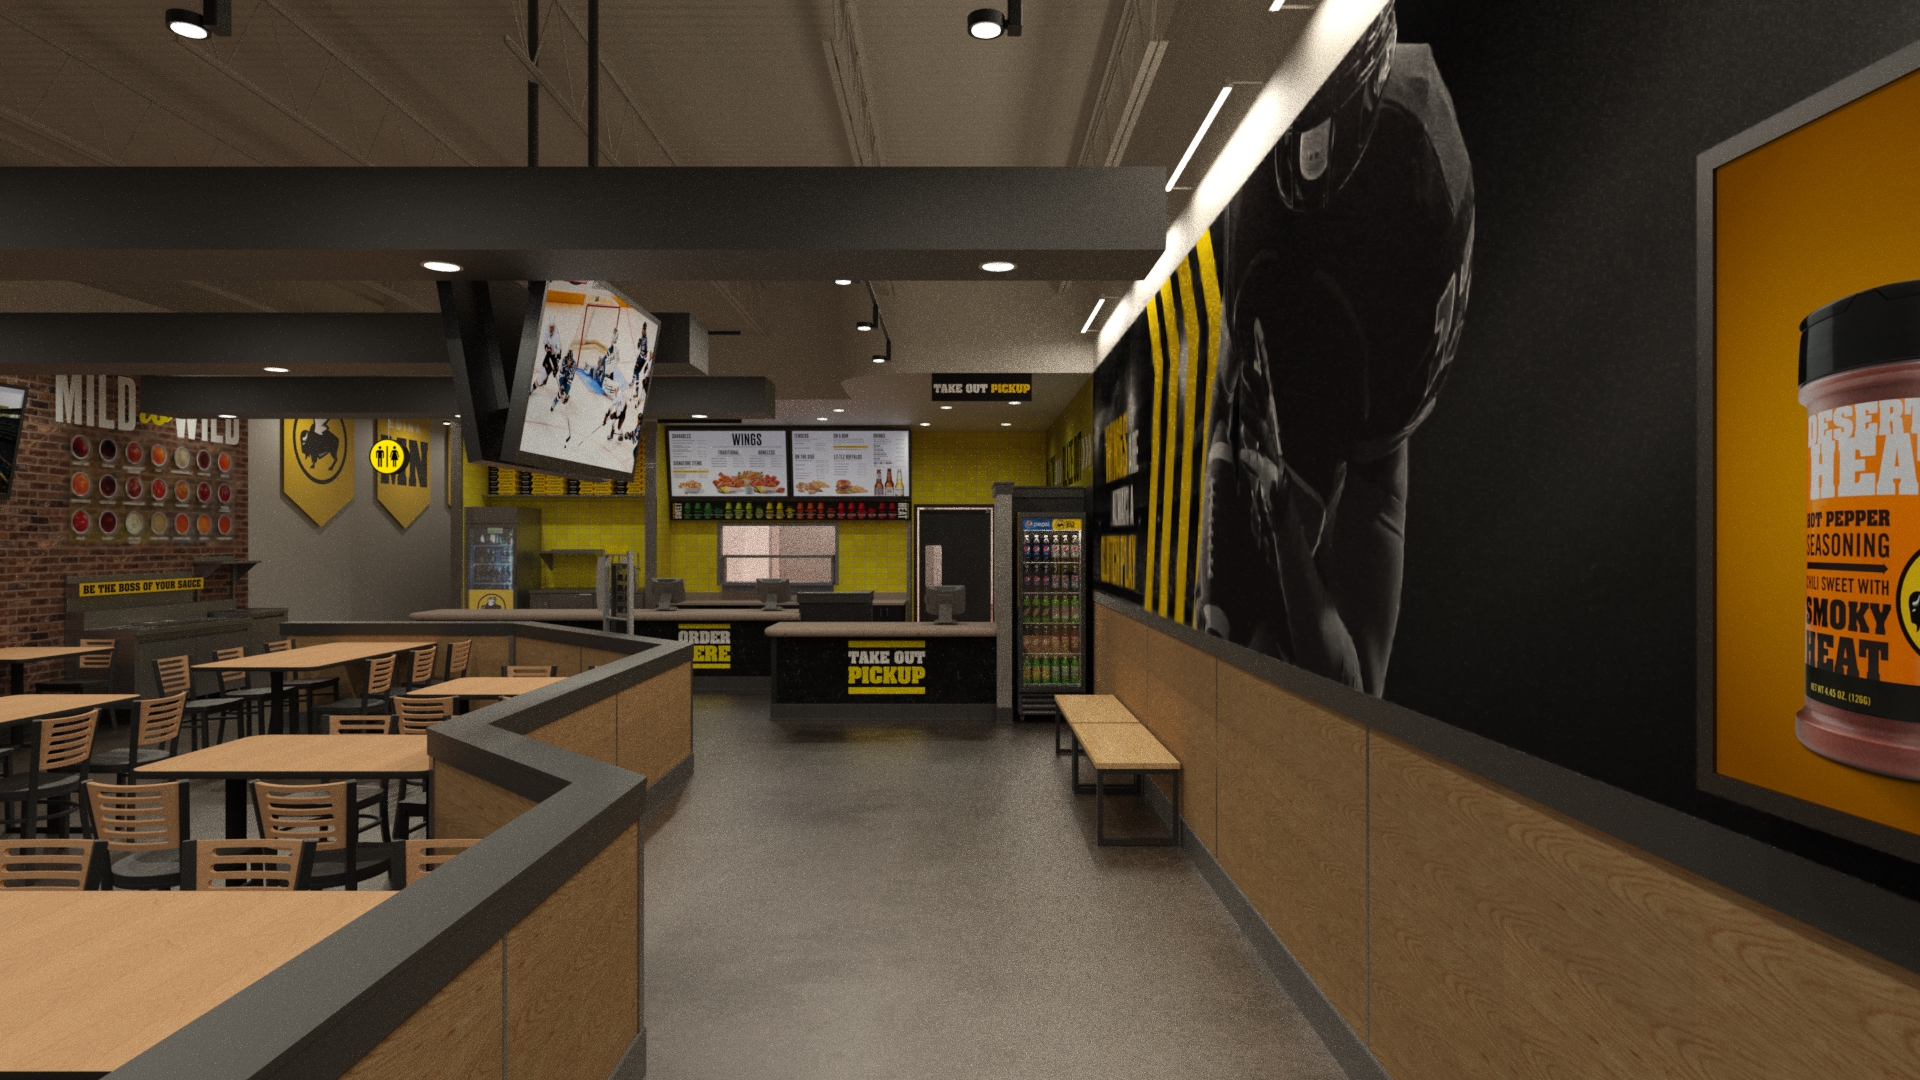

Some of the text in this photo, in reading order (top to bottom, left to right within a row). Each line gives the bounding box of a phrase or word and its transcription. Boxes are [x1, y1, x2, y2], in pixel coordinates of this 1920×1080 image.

[933, 383, 1031, 394] TAKE OUT PICKUP
[55, 375, 136, 431] MILD
[1808, 398, 1920, 448] DESERT
[732, 433, 762, 446] WINGS
[1810, 433, 1920, 500] HEA
[898, 502, 908, 520] HEAT
[1807, 509, 1890, 528] HOT PEPPER
[1807, 533, 1890, 558] SEASONING
[83, 579, 201, 594] BE THE BOSS OF YOUR SAUCE
[1821, 576, 1854, 593] SWEET
[1858, 578, 1889, 596] WITH
[1806, 596, 1891, 635] SMOKY
[678, 630, 731, 645] ORDER
[692, 645, 731, 662] ERE
[848, 651, 926, 665] TAKE OUT
[1806, 630, 1889, 680] HEAT
[848, 666, 926, 684] PICKUP
